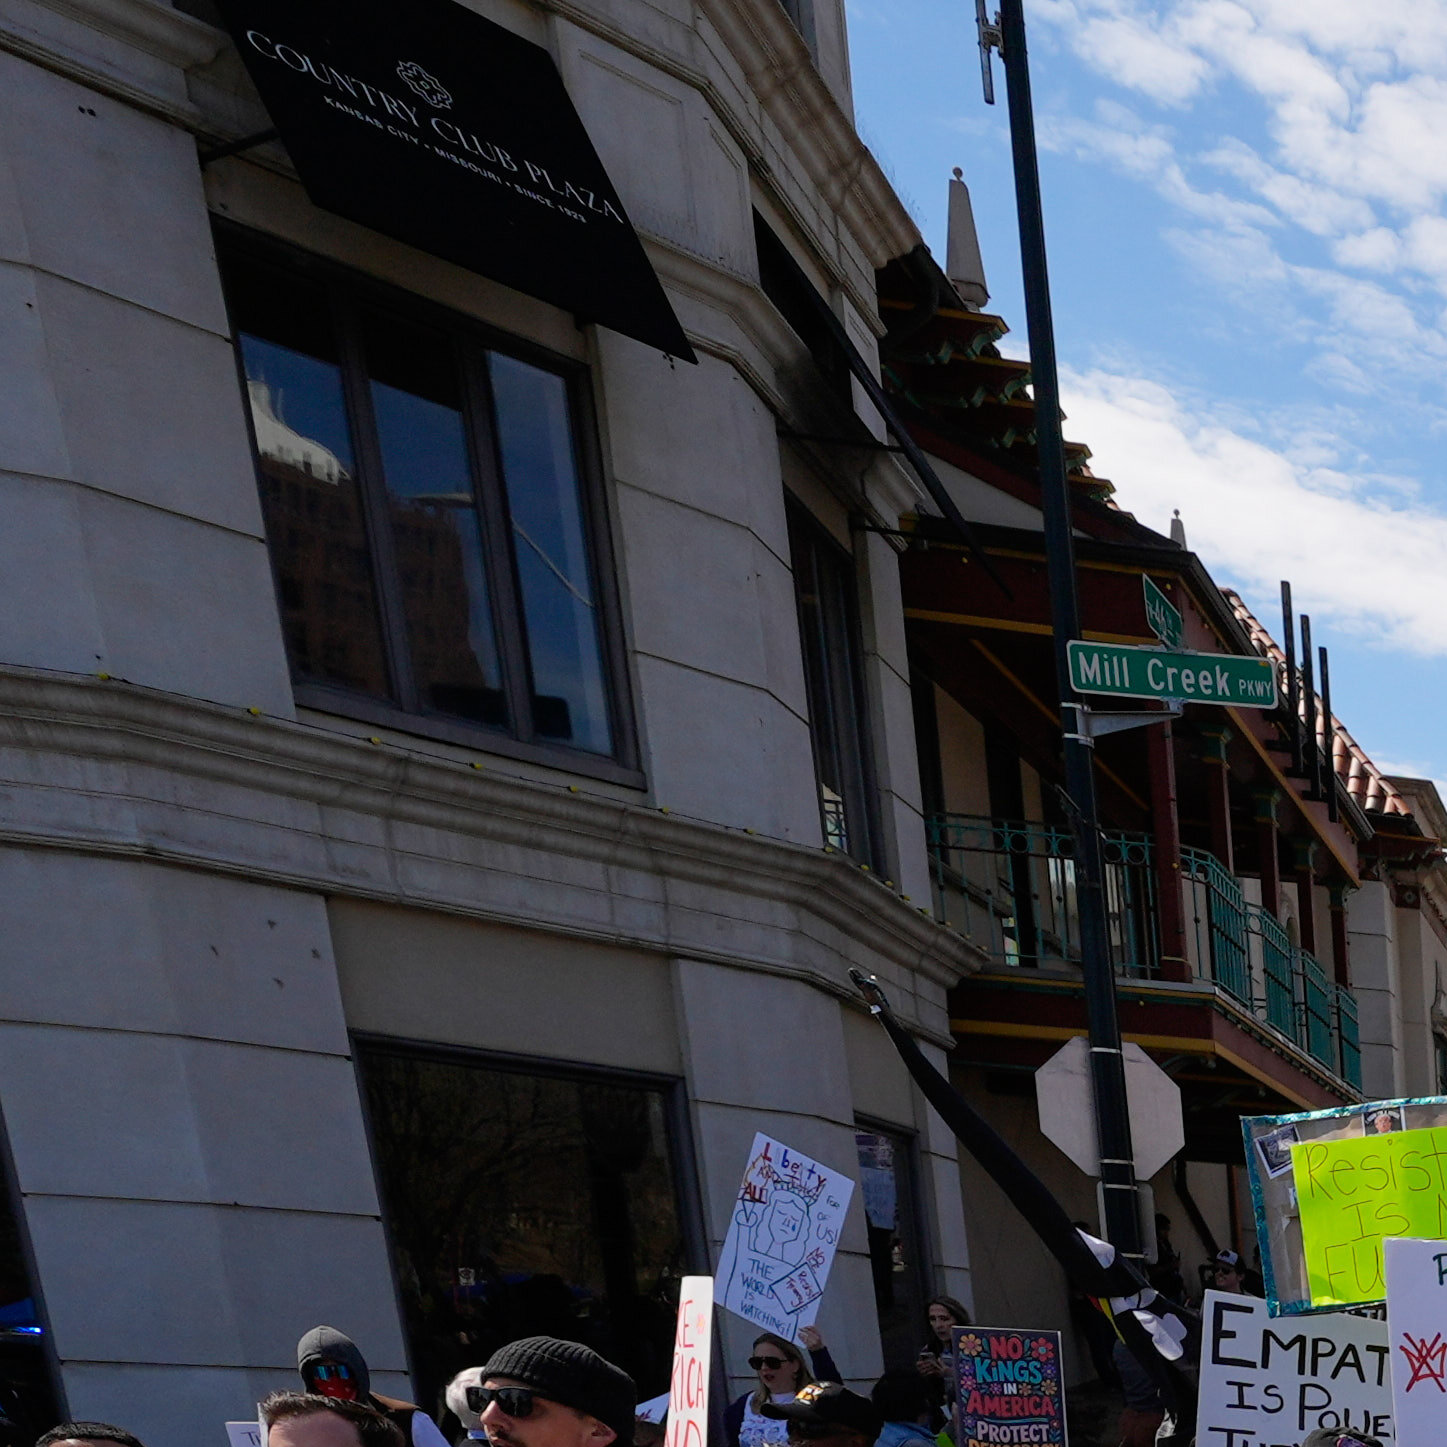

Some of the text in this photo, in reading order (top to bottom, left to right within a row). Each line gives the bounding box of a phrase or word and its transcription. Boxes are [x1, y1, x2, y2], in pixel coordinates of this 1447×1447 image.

[247, 30, 624, 224] COUNTRY CLUB PLAZA
[323, 96, 384, 129] KANSAS
[387, 126, 420, 145] CITY
[434, 148, 502, 184] MISSOURI
[515, 184, 555, 210] SINCE
[1078, 652, 1272, 697] Mill Creek PKWY
[748, 1258, 775, 1280] THE
[740, 1272, 776, 1299] WORLD
[740, 1303, 792, 1336] WATCHING!
[990, 1336, 1023, 1359] NO
[1003, 1383, 1017, 1395] IN
[966, 1390, 1056, 1418] AMERICA
[1225, 1380, 1396, 1438] IS POWE
[976, 1421, 1049, 1443] PROTECT
